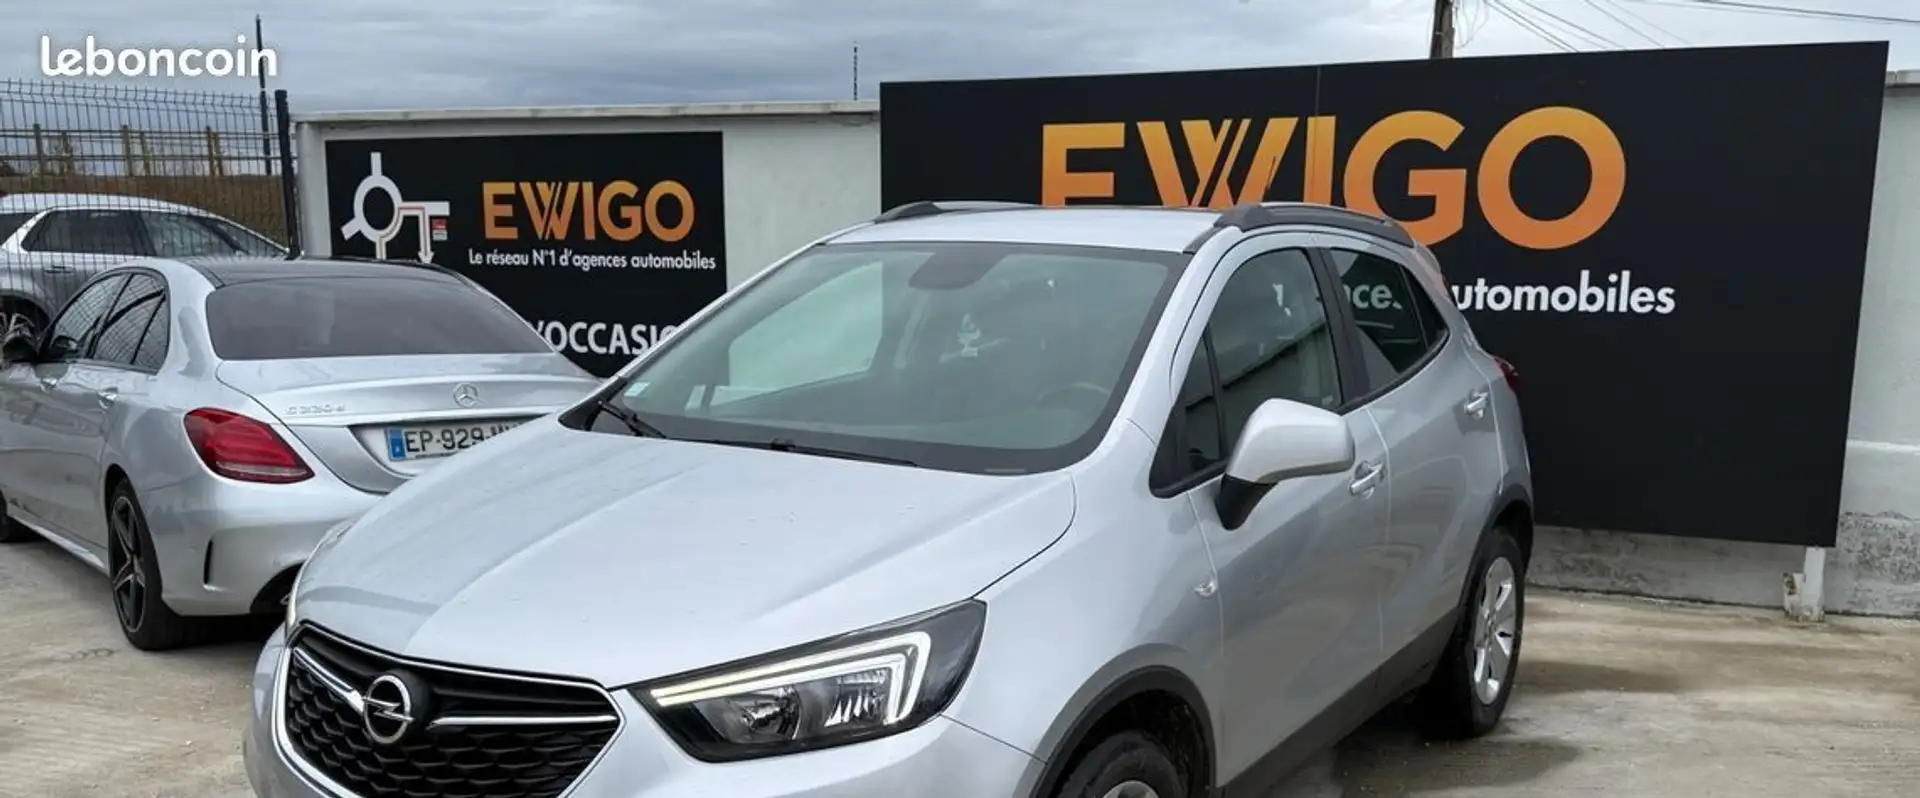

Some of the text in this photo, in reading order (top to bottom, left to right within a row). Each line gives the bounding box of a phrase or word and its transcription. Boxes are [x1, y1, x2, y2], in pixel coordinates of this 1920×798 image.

[1041, 106, 1627, 250] EWIGO
[482, 179, 695, 242] EWIGO
[468, 248, 484, 265] Le
[486, 248, 530, 266] réseau
[559, 248, 628, 272] d'agences
[631, 250, 717, 270] automobiles
[1450, 269, 1676, 315] utomobiles
